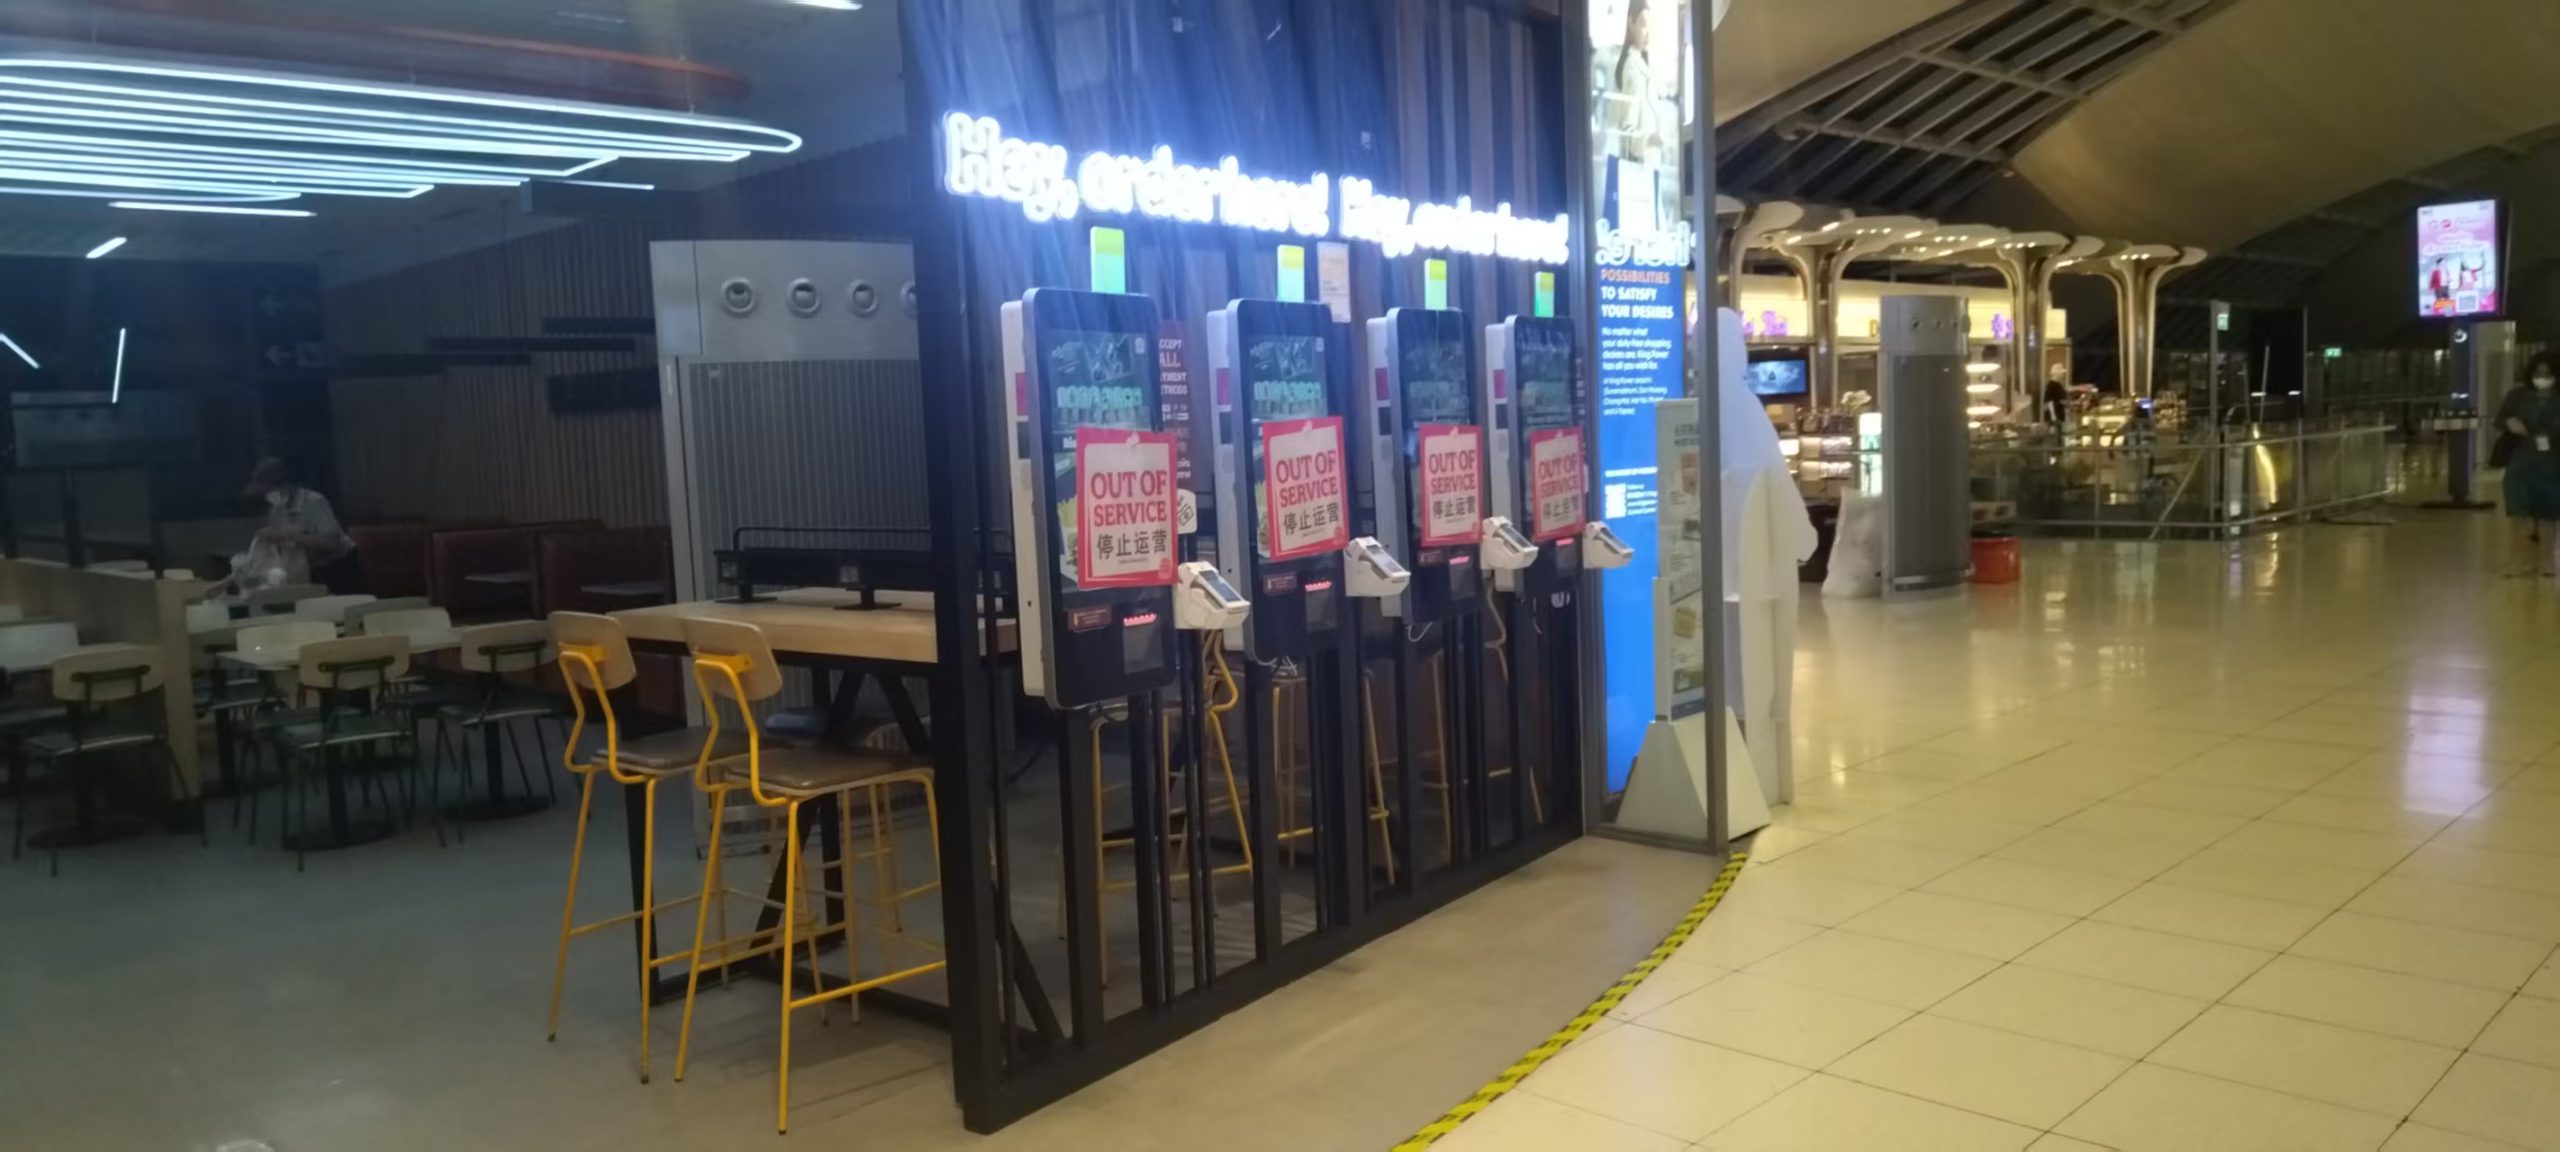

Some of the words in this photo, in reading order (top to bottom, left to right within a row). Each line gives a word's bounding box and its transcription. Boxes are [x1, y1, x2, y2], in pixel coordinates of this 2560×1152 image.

[1601, 268, 1670, 284] POSSIBILITIES
[1601, 286, 1616, 300] TO
[1617, 286, 1657, 301] SATISFY
[1601, 304, 1630, 318] YOUR
[1631, 305, 1674, 319] DESIRES
[1159, 339, 1182, 350] CCEPT
[1160, 372, 1187, 382] YMENT
[1276, 455, 1312, 484] OUT
[1315, 450, 1337, 474] OF
[1428, 451, 1457, 474] OUT
[1459, 449, 1476, 470] OF
[1539, 457, 1562, 479] OUT
[1563, 452, 1577, 473] OF
[1091, 471, 1137, 499] OUT
[1139, 470, 1168, 496] OF
[1279, 476, 1338, 508] SERVICE
[1430, 473, 1476, 496] SERVICE
[1094, 501, 1168, 527] SERVICE
[1284, 501, 1340, 535] 停止运营
[1097, 529, 1168, 560] 停止运营
